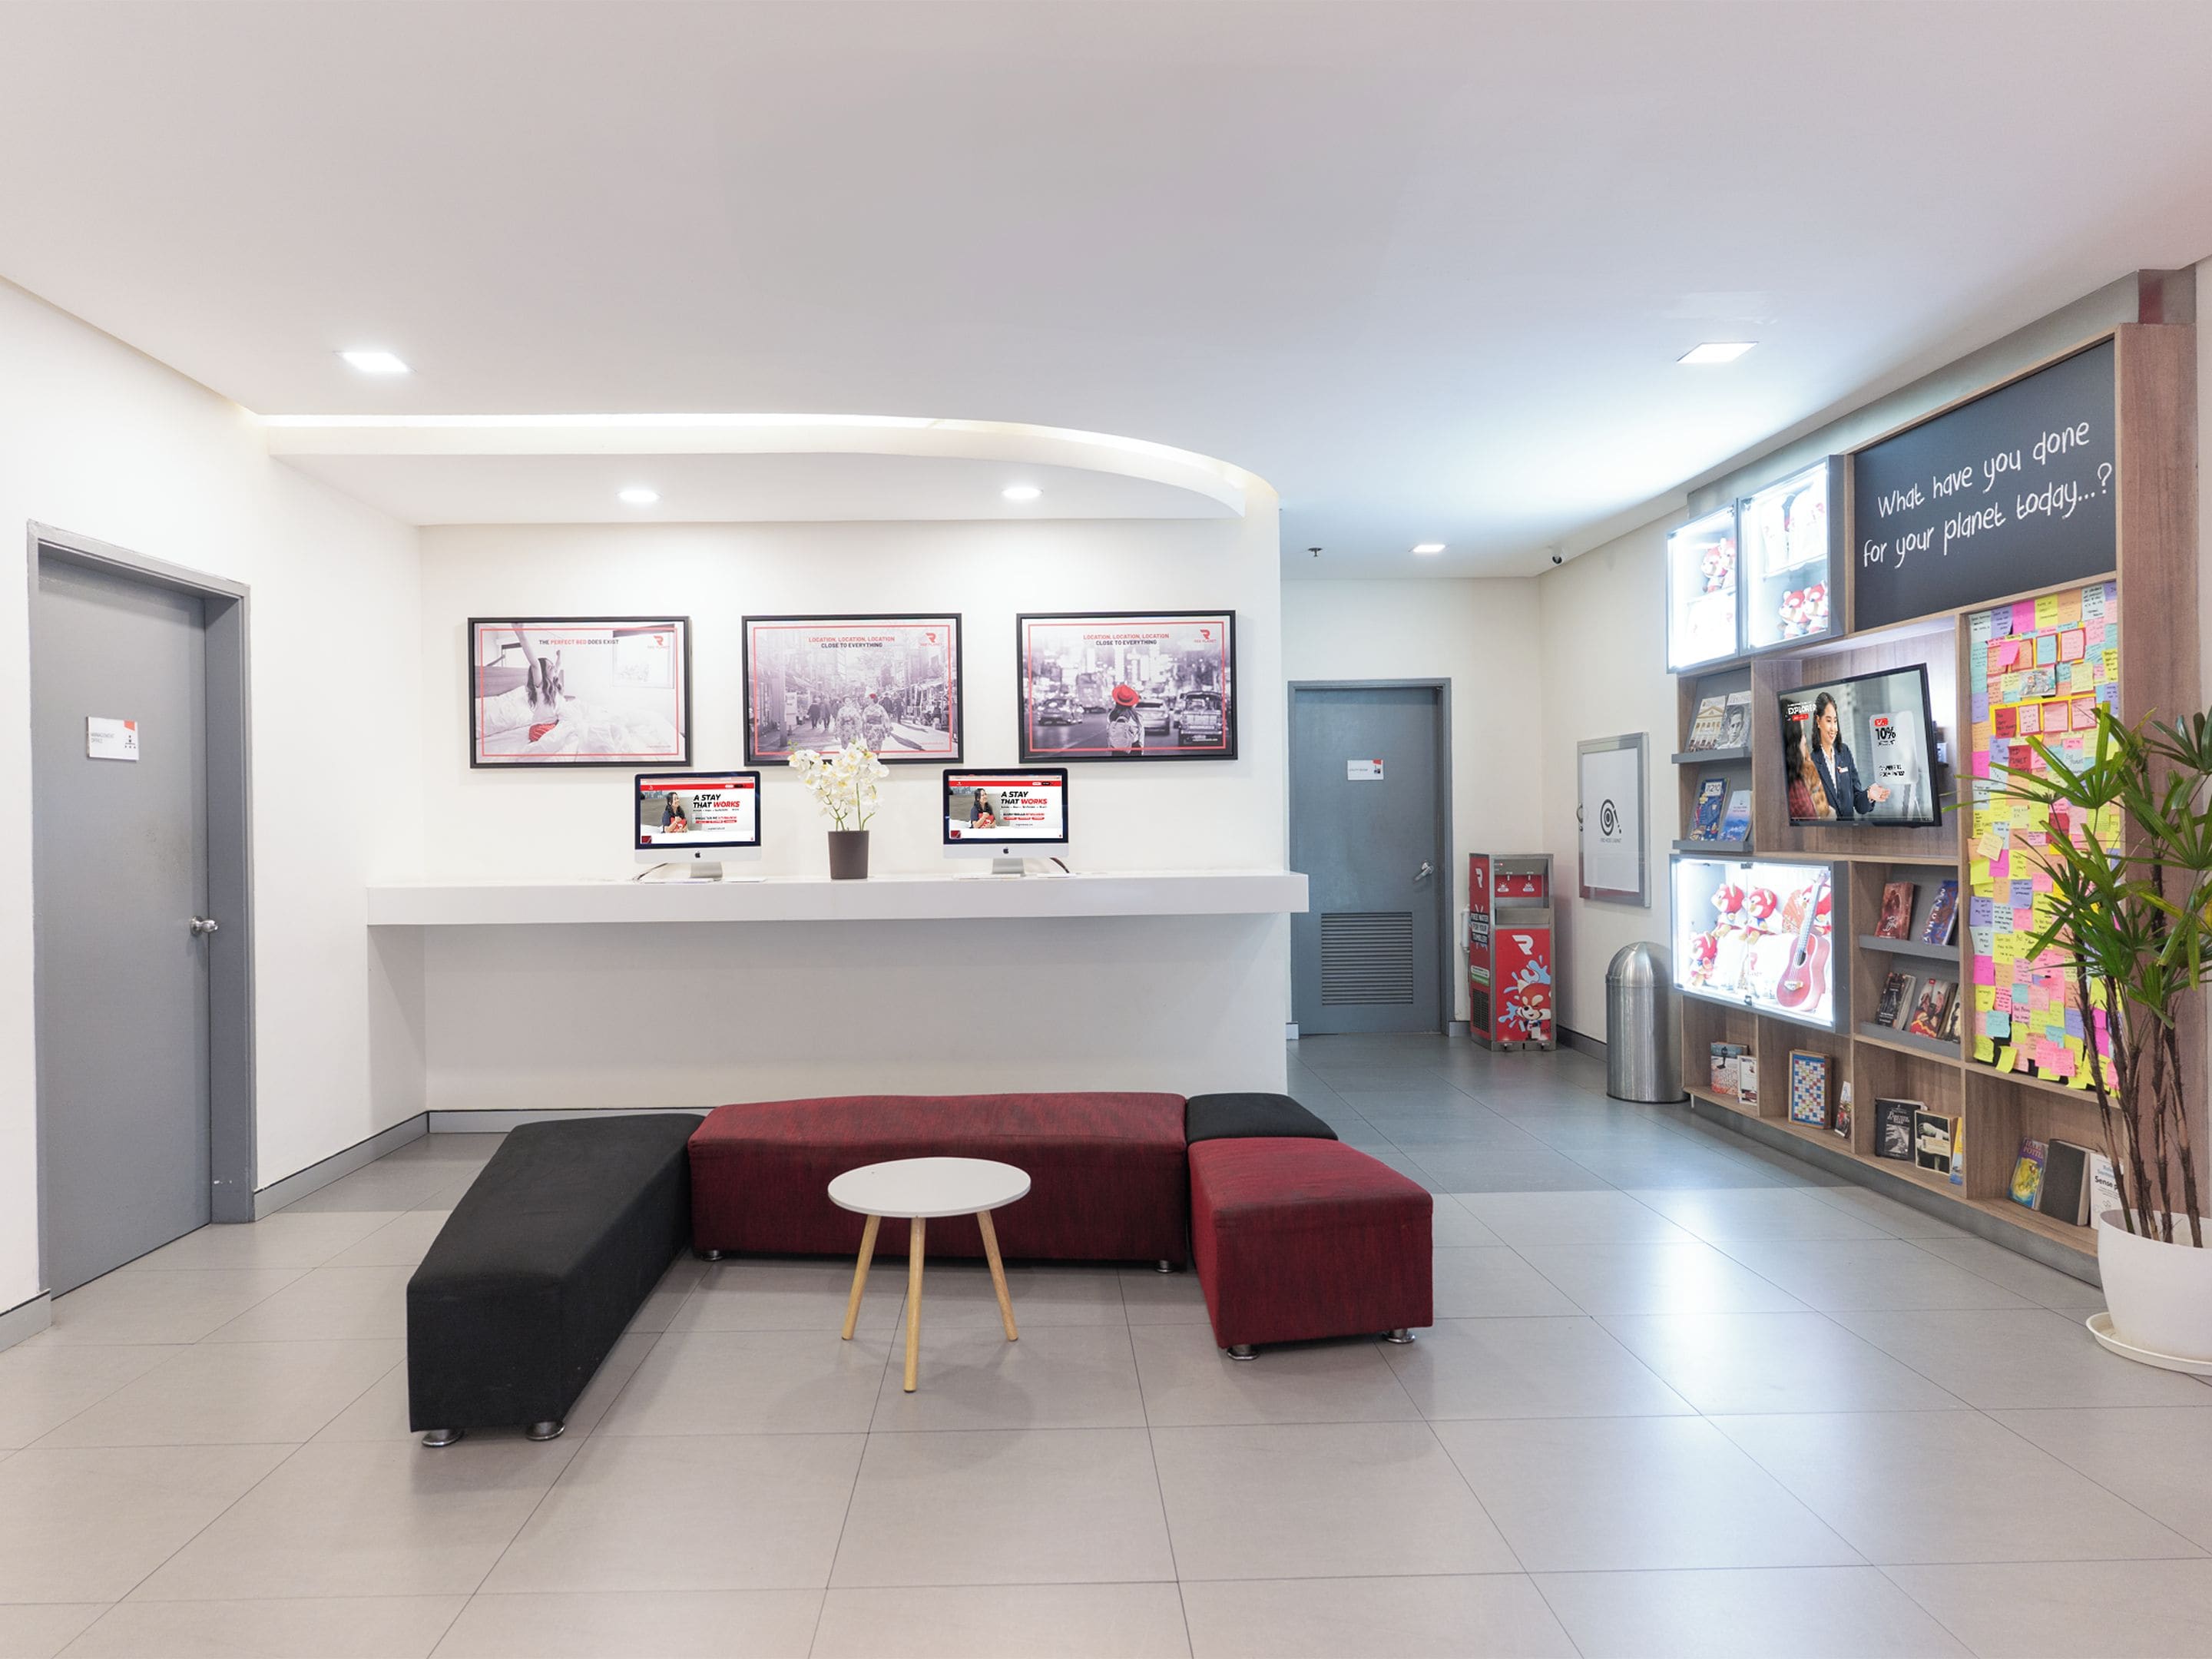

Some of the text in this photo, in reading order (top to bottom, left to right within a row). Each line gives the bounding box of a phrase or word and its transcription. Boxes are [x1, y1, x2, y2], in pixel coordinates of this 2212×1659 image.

[1877, 422, 2090, 518] What have you done
[1863, 539, 1887, 568] for
[1894, 527, 1935, 568] your
[1943, 502, 2006, 555] planet
[1875, 726, 1896, 740] 10%
[2094, 1175, 2113, 1188] Sense
